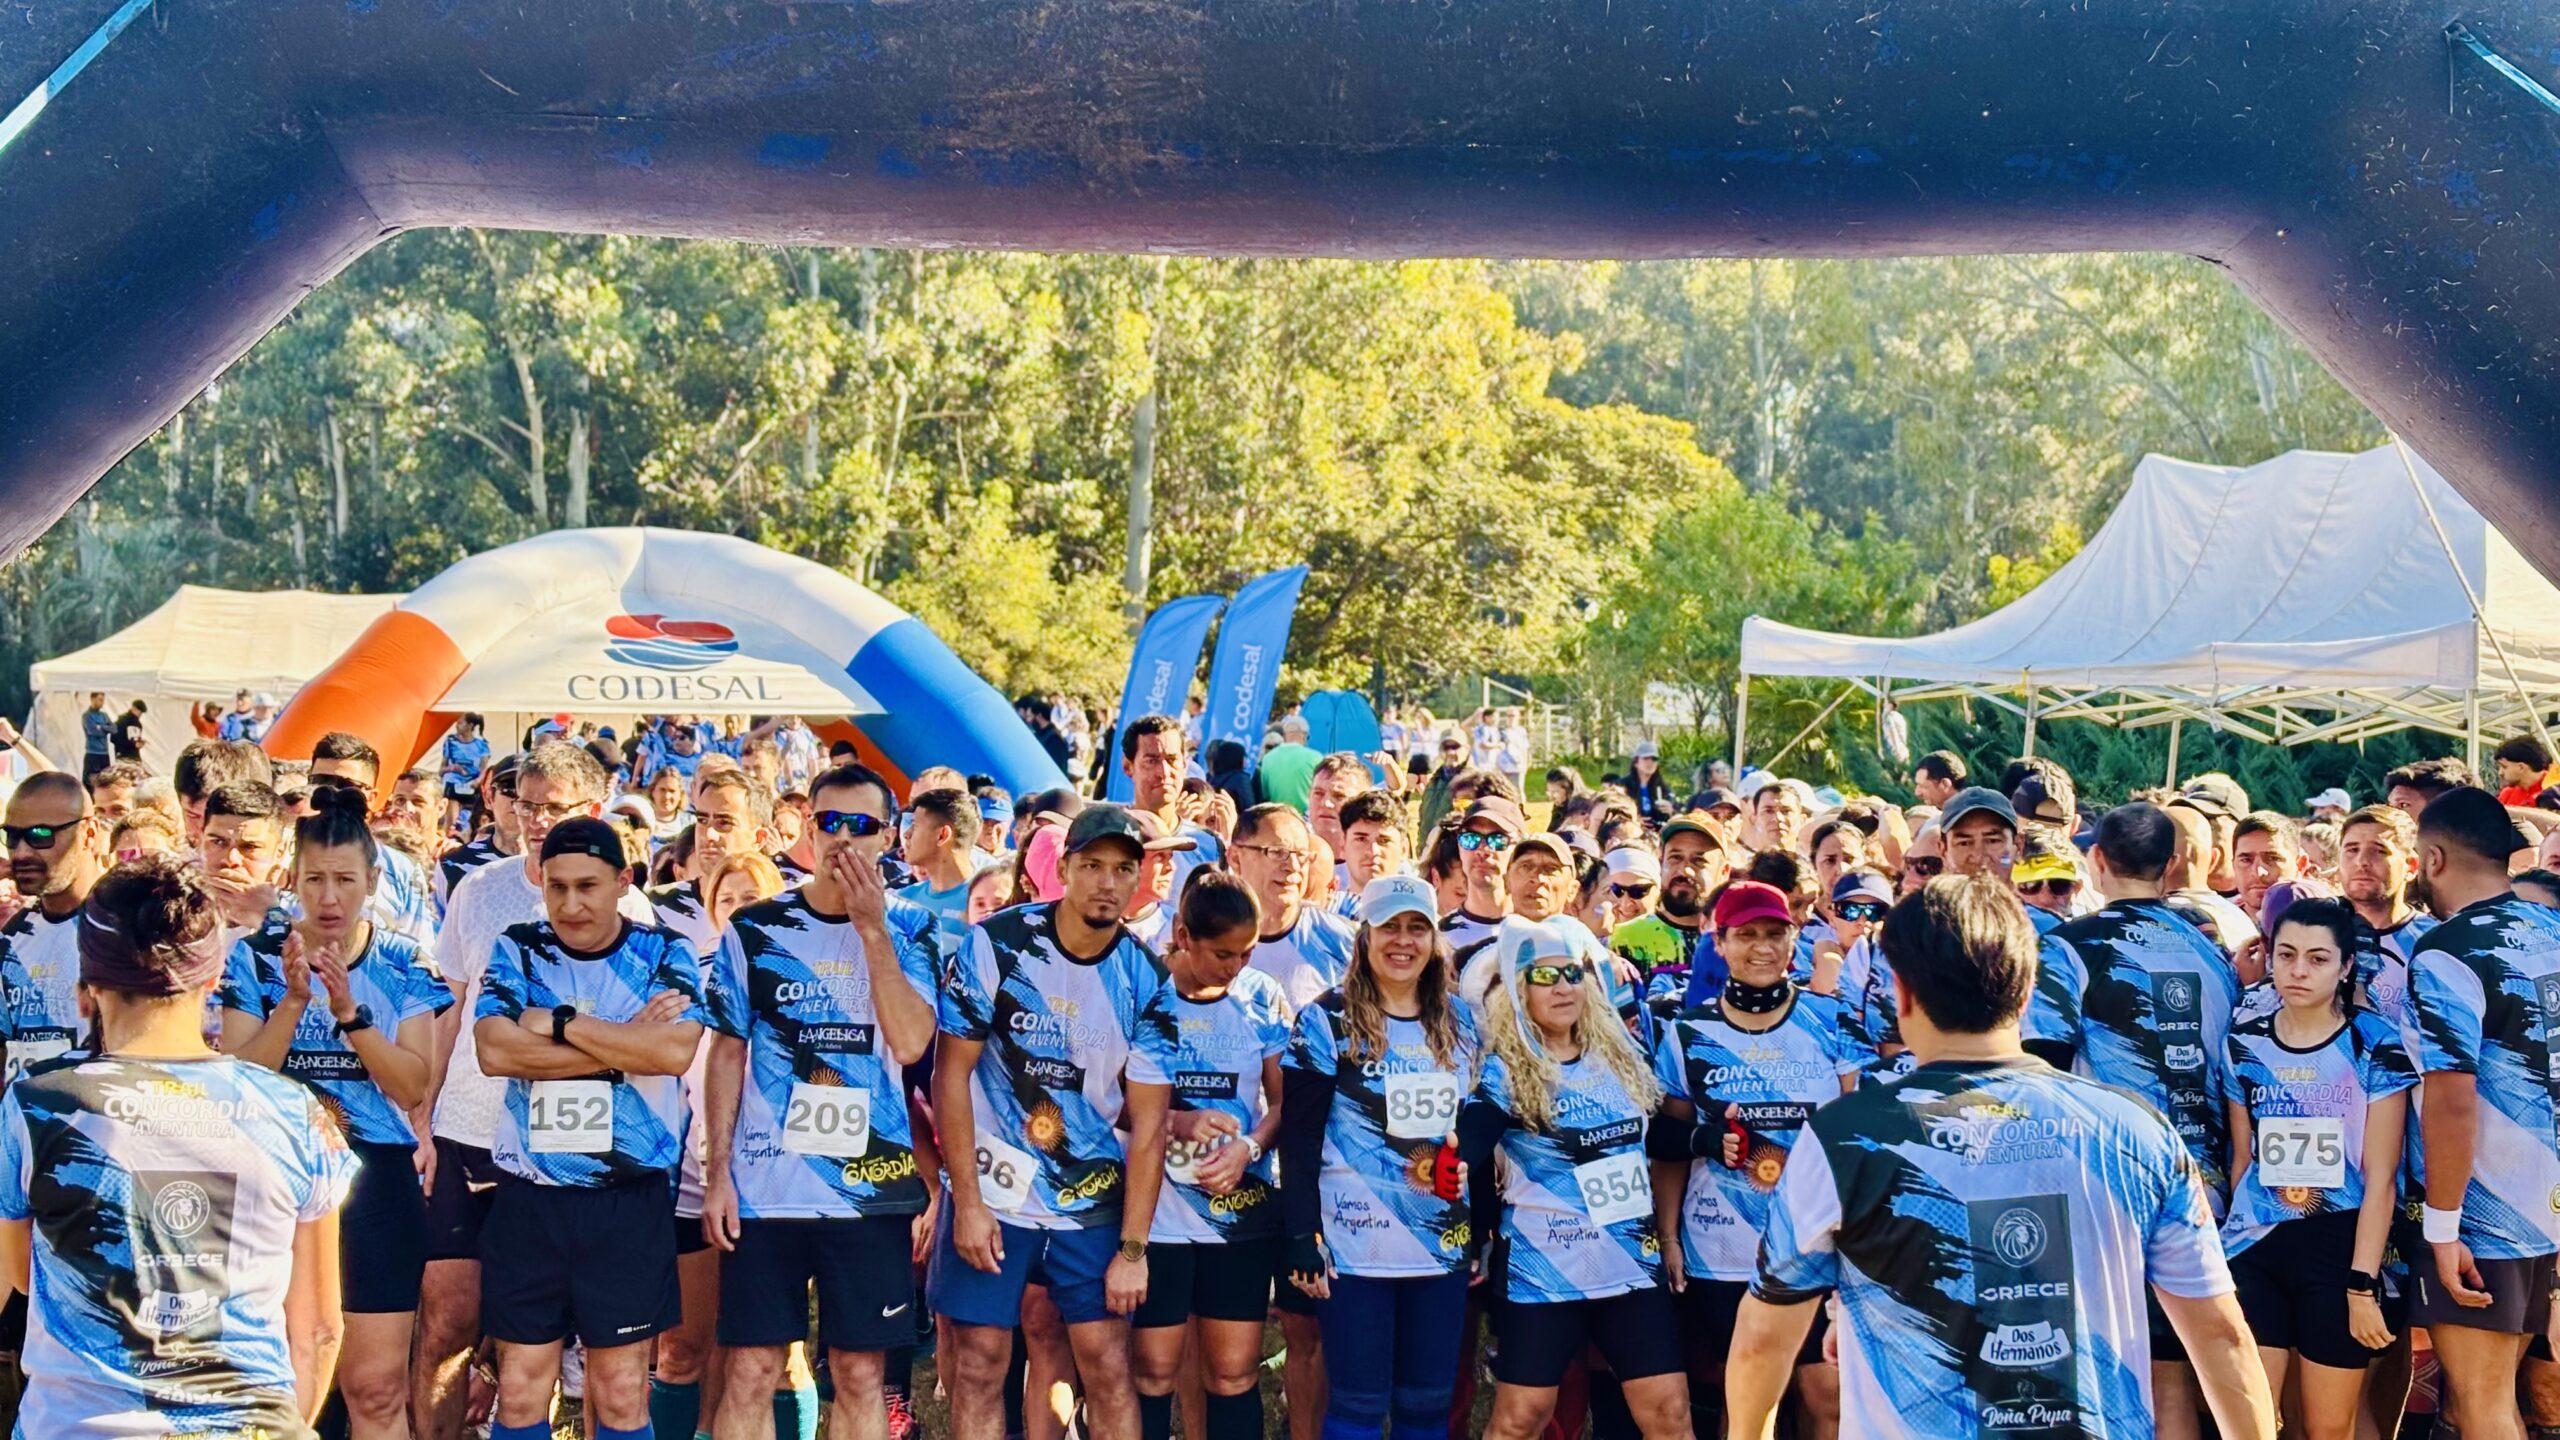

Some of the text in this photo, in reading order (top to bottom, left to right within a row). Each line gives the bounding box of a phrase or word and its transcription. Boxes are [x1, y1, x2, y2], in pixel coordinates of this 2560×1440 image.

[567, 674, 783, 701] CODESAL
[1145, 659, 1174, 716] desal
[1233, 644, 1263, 730] codesal
[775, 977, 872, 1002] CONCORD
[1703, 1061, 1824, 1086] CONCORDIA
[1722, 1078, 1807, 1096] AVENTURA
[104, 1096, 260, 1122] CONCORDIA
[530, 1097, 609, 1131] 152
[1389, 1087, 1457, 1121] 853
[1736, 1105, 1808, 1122] ANGELICA
[1973, 1102, 2032, 1119] TRAIL
[131, 1120, 236, 1138] AVENTURA
[786, 1099, 867, 1137] 209
[1930, 1117, 2085, 1150] CONCORDIA
[1960, 1139, 2064, 1167] AVENTURA
[2261, 1131, 2342, 1167] 675
[1583, 1165, 1649, 1209] 854
[1334, 1191, 1371, 1210] Vamos
[1333, 1210, 1391, 1236] Argentina
[1545, 1212, 1580, 1229] Vamos
[1547, 1227, 1600, 1251] Argentina
[169, 1296, 193, 1311] Dos
[1978, 1282, 2070, 1302] GREECE
[2011, 1328, 2036, 1344] Dos
[1989, 1340, 2063, 1361] Hermanos
[1981, 1406, 2027, 1429] Doña
